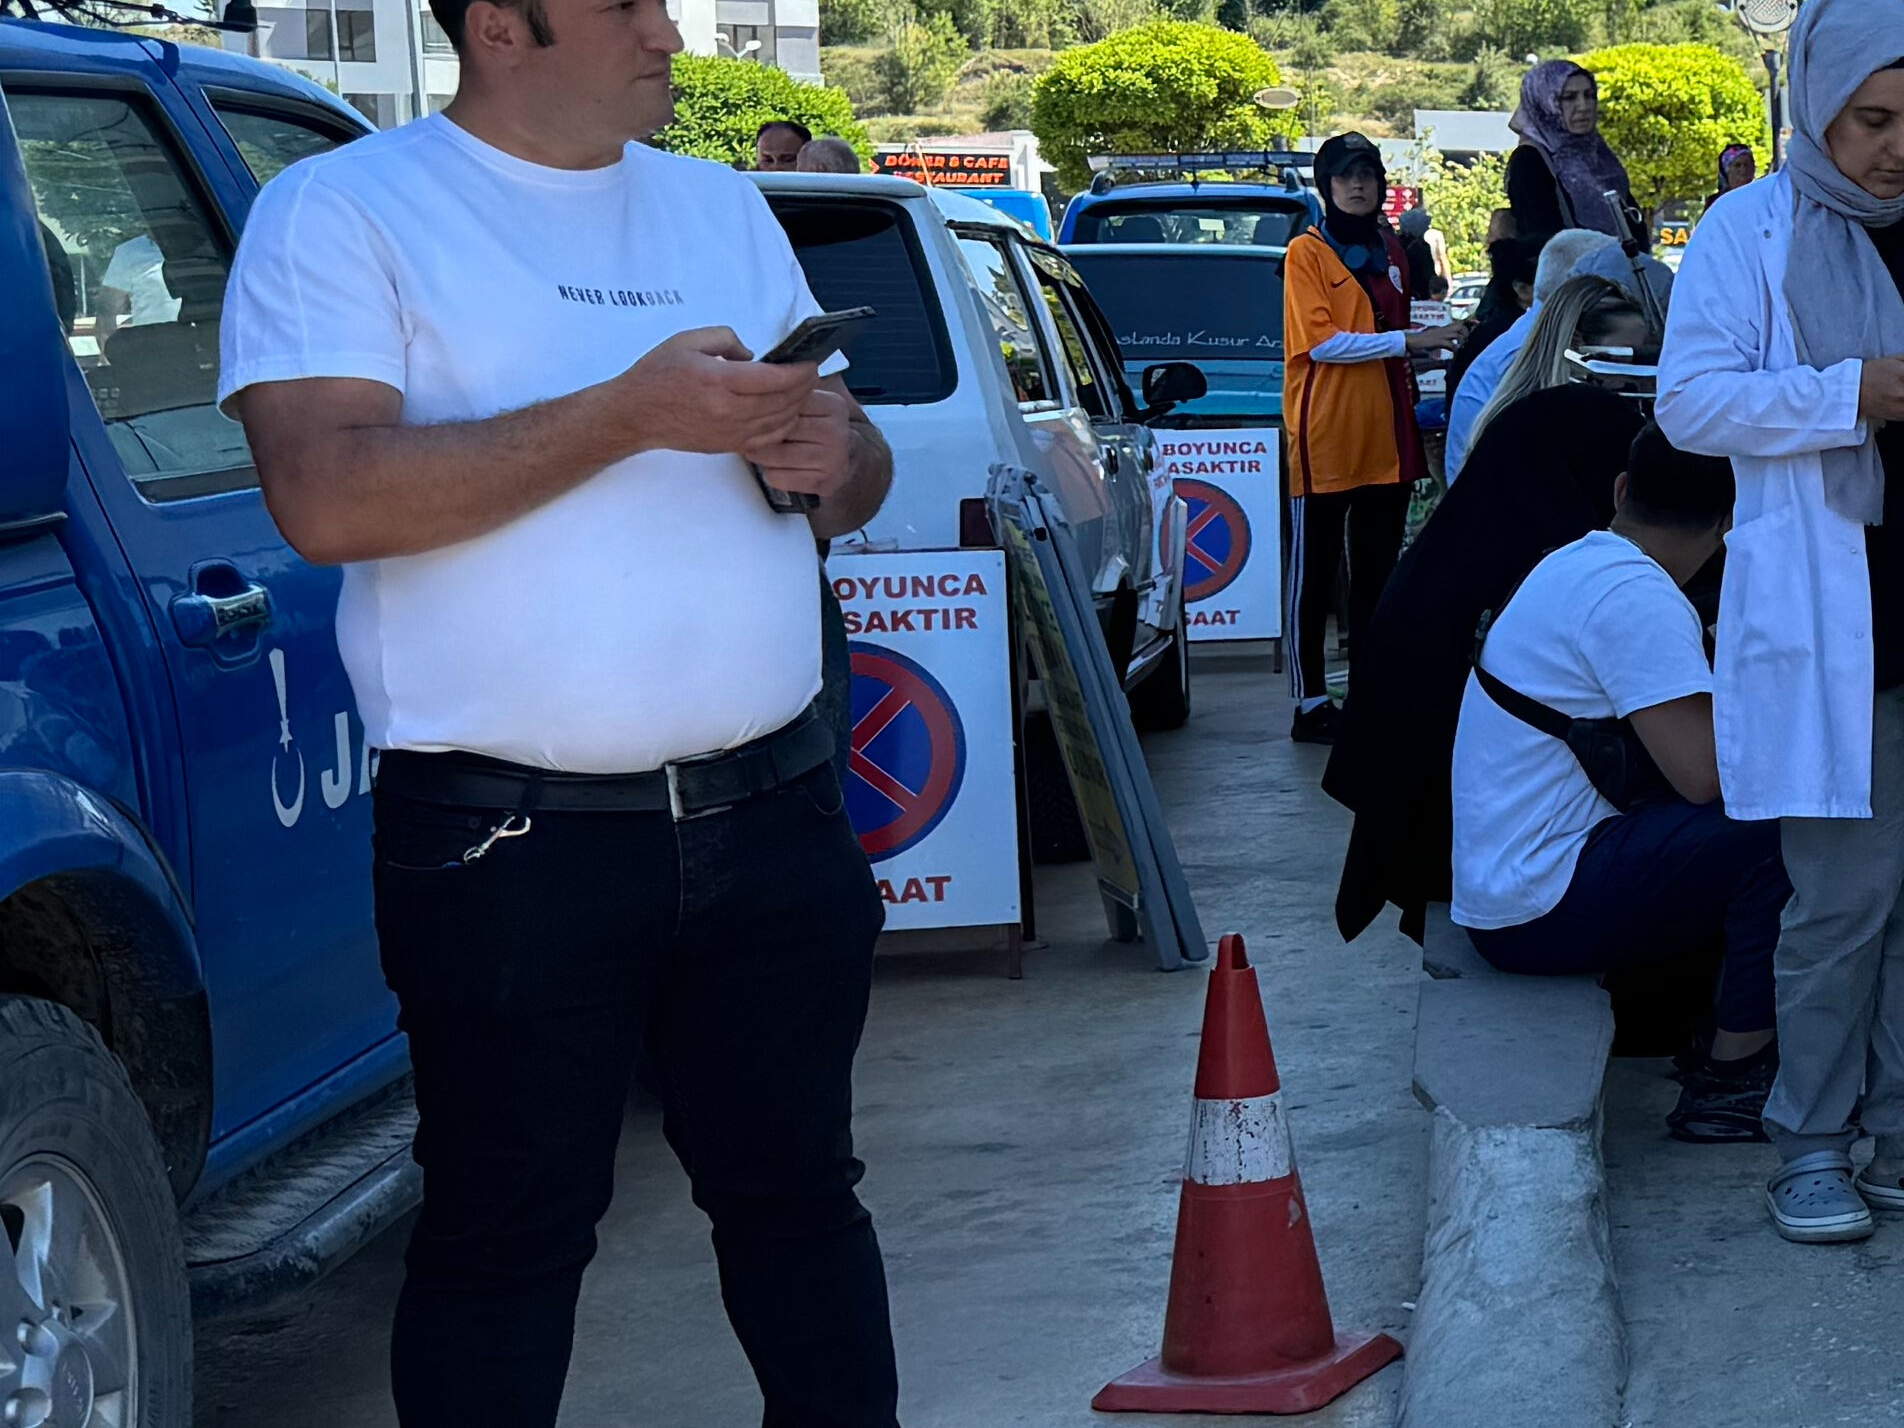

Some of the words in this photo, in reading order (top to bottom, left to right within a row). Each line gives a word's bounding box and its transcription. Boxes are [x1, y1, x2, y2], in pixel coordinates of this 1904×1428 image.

[558, 284, 605, 305] NEVER
[1187, 330, 1249, 346] Kusur
[1162, 441, 1267, 456] BOYUNCA
[1168, 460, 1261, 475] ASAKTIR
[832, 573, 988, 601] OYUNCA
[844, 607, 978, 635] SAKTIR
[875, 875, 952, 904] AAT
